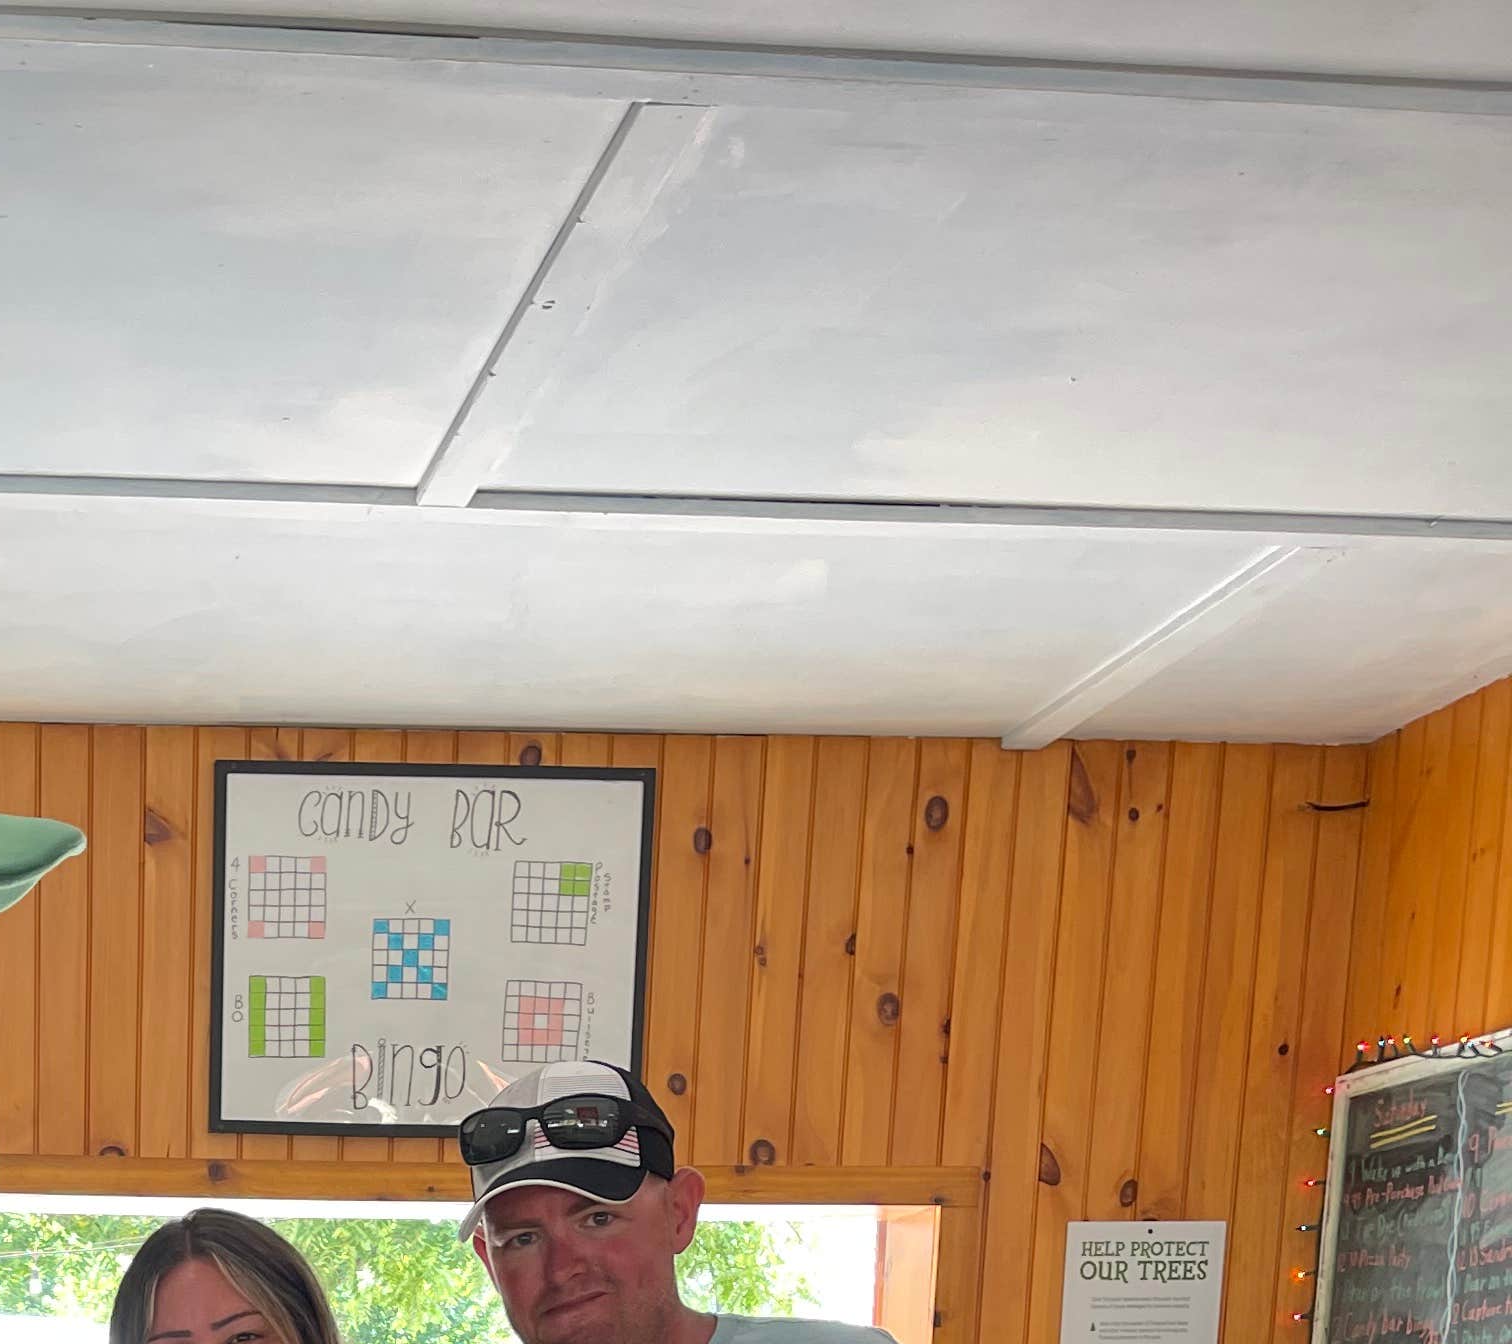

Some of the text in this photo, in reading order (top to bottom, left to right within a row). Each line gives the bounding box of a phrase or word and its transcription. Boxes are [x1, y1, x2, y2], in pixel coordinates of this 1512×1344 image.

[405, 901, 415, 914] X
[1081, 1241, 1209, 1258] HELP PROTECT
[1080, 1260, 1208, 1283] OUR TREES
